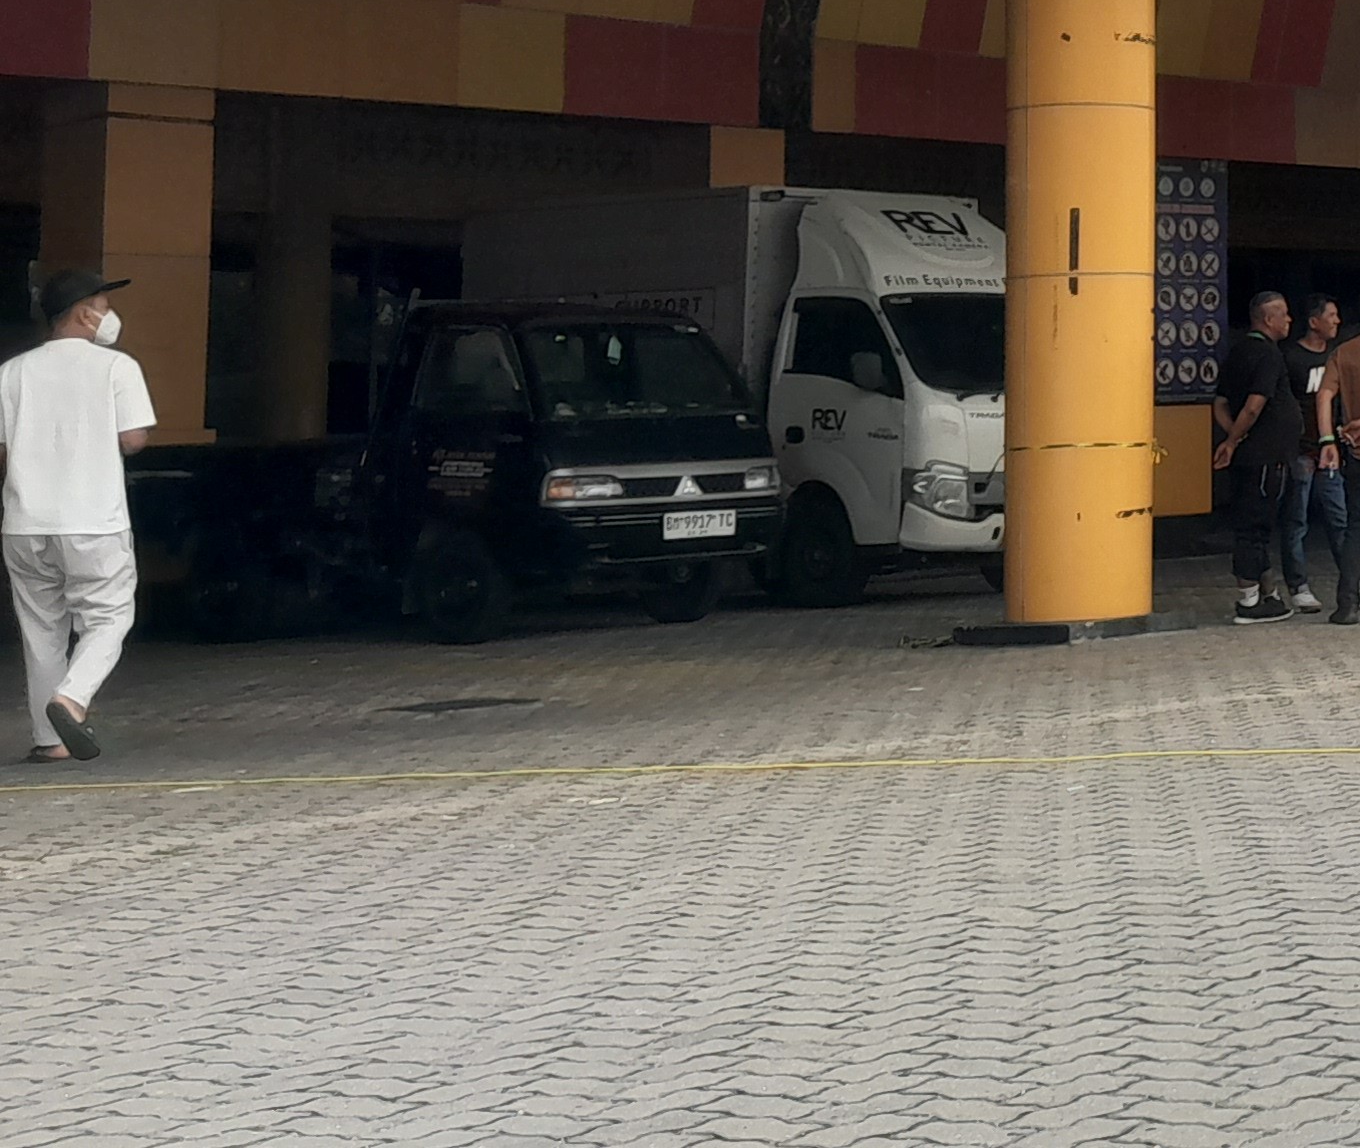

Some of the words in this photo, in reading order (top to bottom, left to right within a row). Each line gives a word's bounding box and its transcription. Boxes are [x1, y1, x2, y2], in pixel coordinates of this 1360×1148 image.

[880, 209, 968, 236] REV
[883, 274, 919, 287] Film
[922, 274, 1000, 288] Equipment
[811, 408, 847, 431] REV
[718, 512, 734, 528] TC
